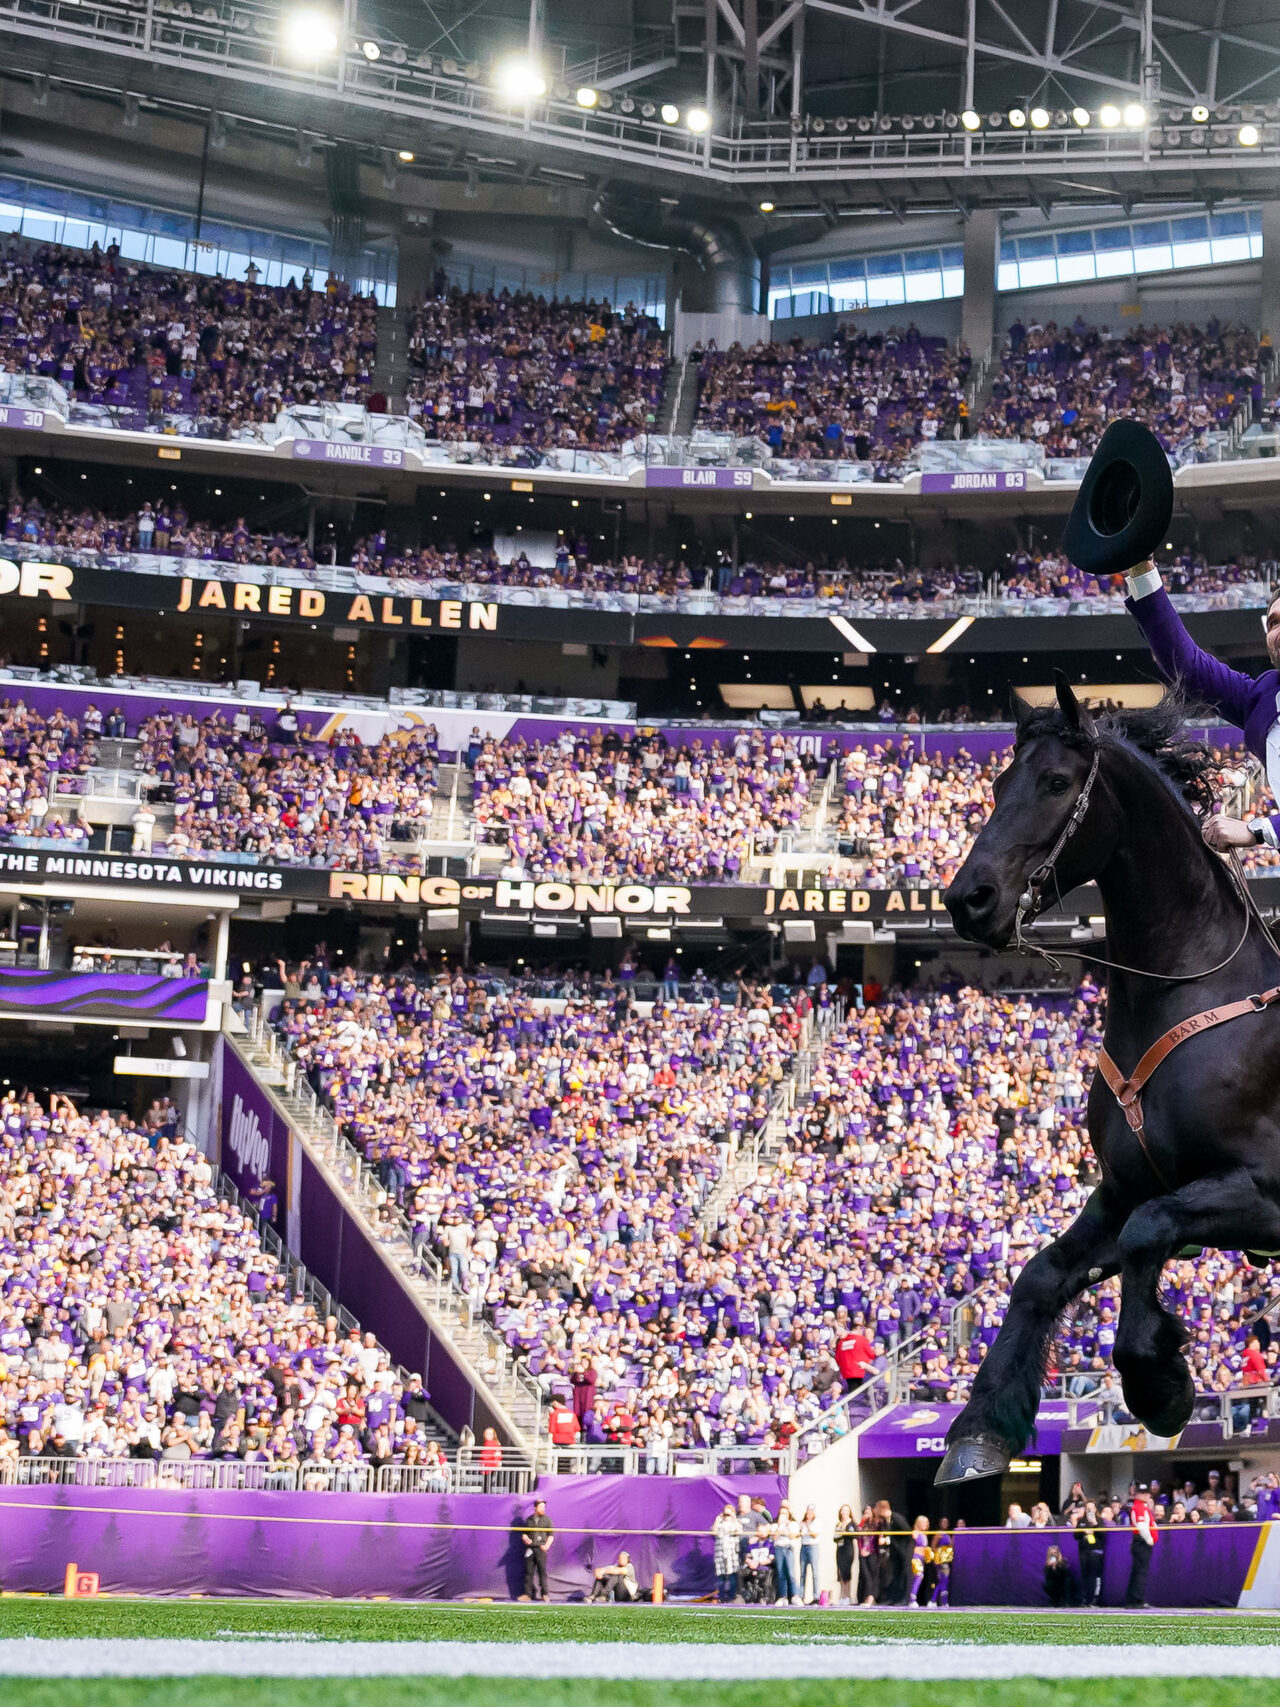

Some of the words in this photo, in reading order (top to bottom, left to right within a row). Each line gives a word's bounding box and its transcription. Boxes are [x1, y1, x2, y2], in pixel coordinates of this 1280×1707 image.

[24, 411, 43, 427] 30
[326, 444, 371, 461] RANDLE
[383, 449, 402, 465] 93
[683, 470, 716, 485] BLAIR
[734, 471, 752, 486] 59
[951, 474, 997, 489] JORDAN
[1005, 473, 1024, 488] 83
[177, 578, 326, 617] JARED
[347, 595, 498, 631] ALLEN
[45, 857, 182, 882] MINNESOTA
[188, 867, 283, 889] VIKINGS
[329, 872, 460, 905] RING
[461, 885, 493, 899] OF
[496, 880, 691, 914] HONOR
[764, 889, 871, 915] JARED
[886, 890, 947, 912] ALL
[1168, 1019, 1201, 1044] BAR
[1203, 1011, 1219, 1025] M
